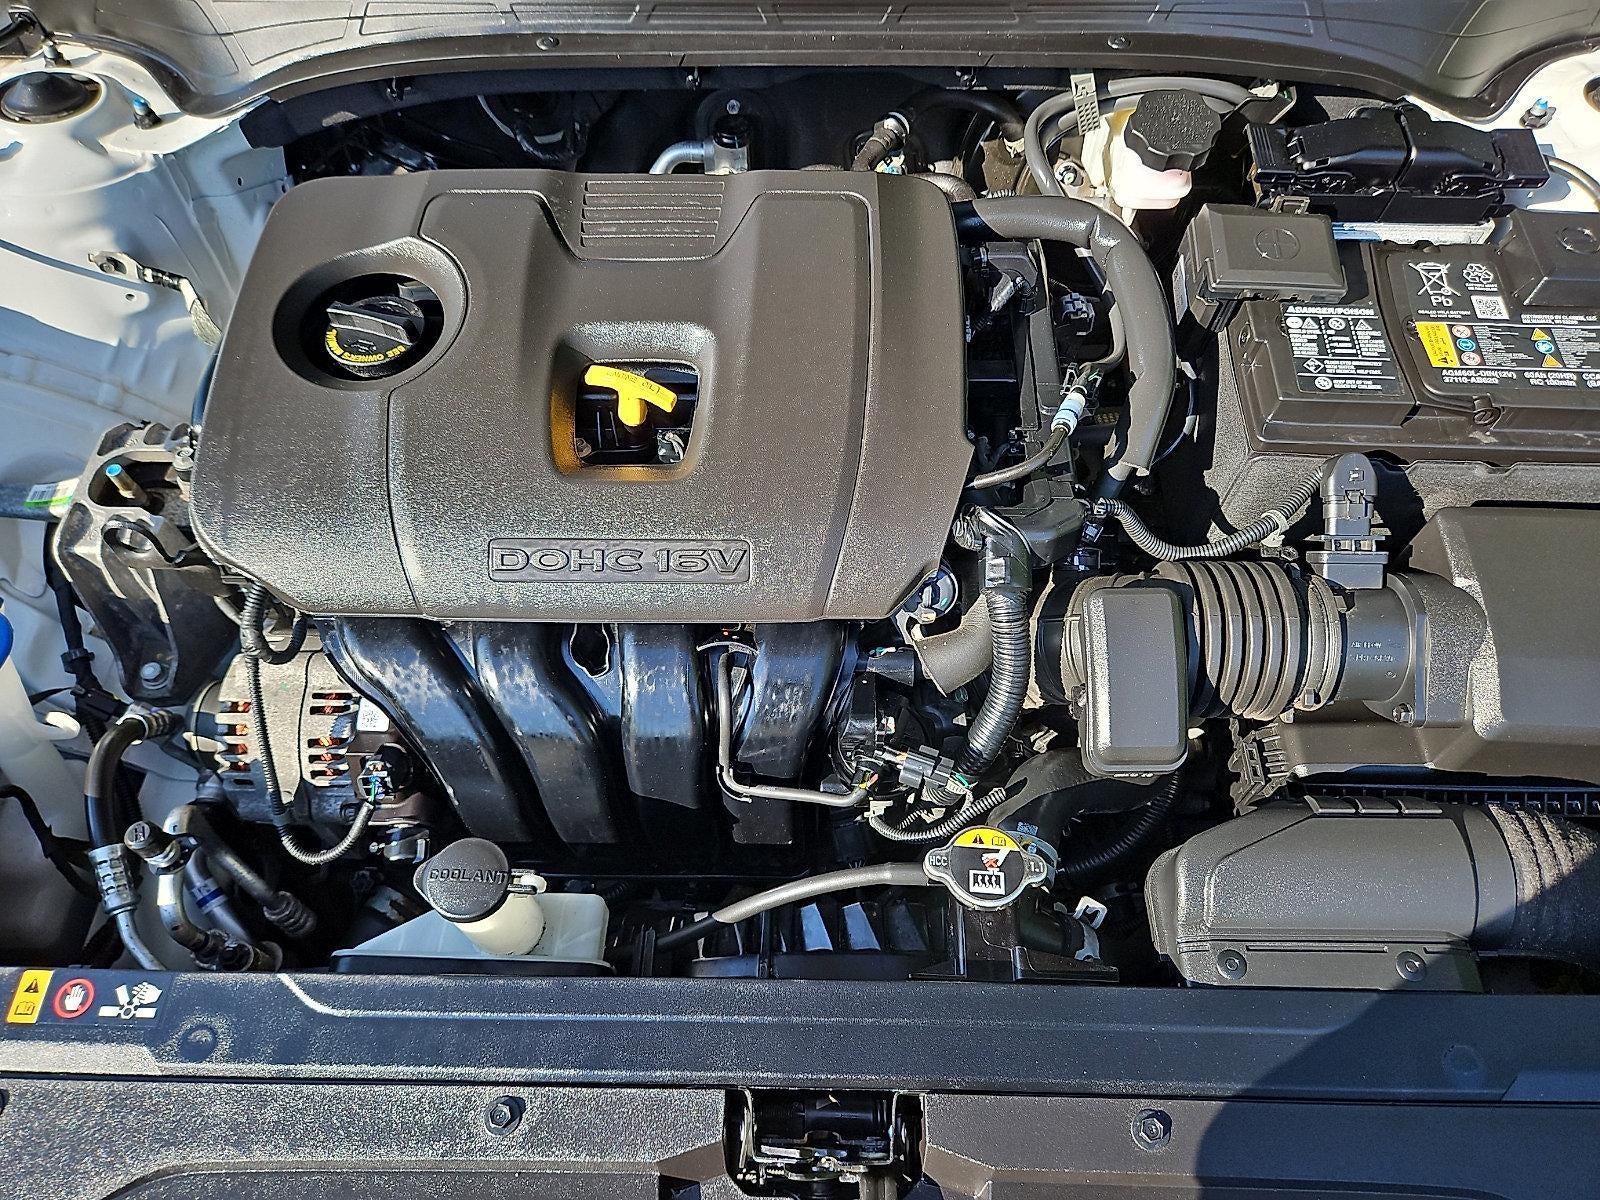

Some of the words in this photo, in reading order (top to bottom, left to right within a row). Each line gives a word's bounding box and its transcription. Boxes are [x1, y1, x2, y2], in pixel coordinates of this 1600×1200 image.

[1430, 295, 1454, 307] Pb
[1295, 305, 1375, 316] DANGER/POISON
[492, 547, 642, 572] DOHC
[657, 548, 747, 573] 16V
[928, 855, 948, 867] HCC
[1030, 862, 1044, 873] 1.1
[429, 868, 508, 885] COOLANT
